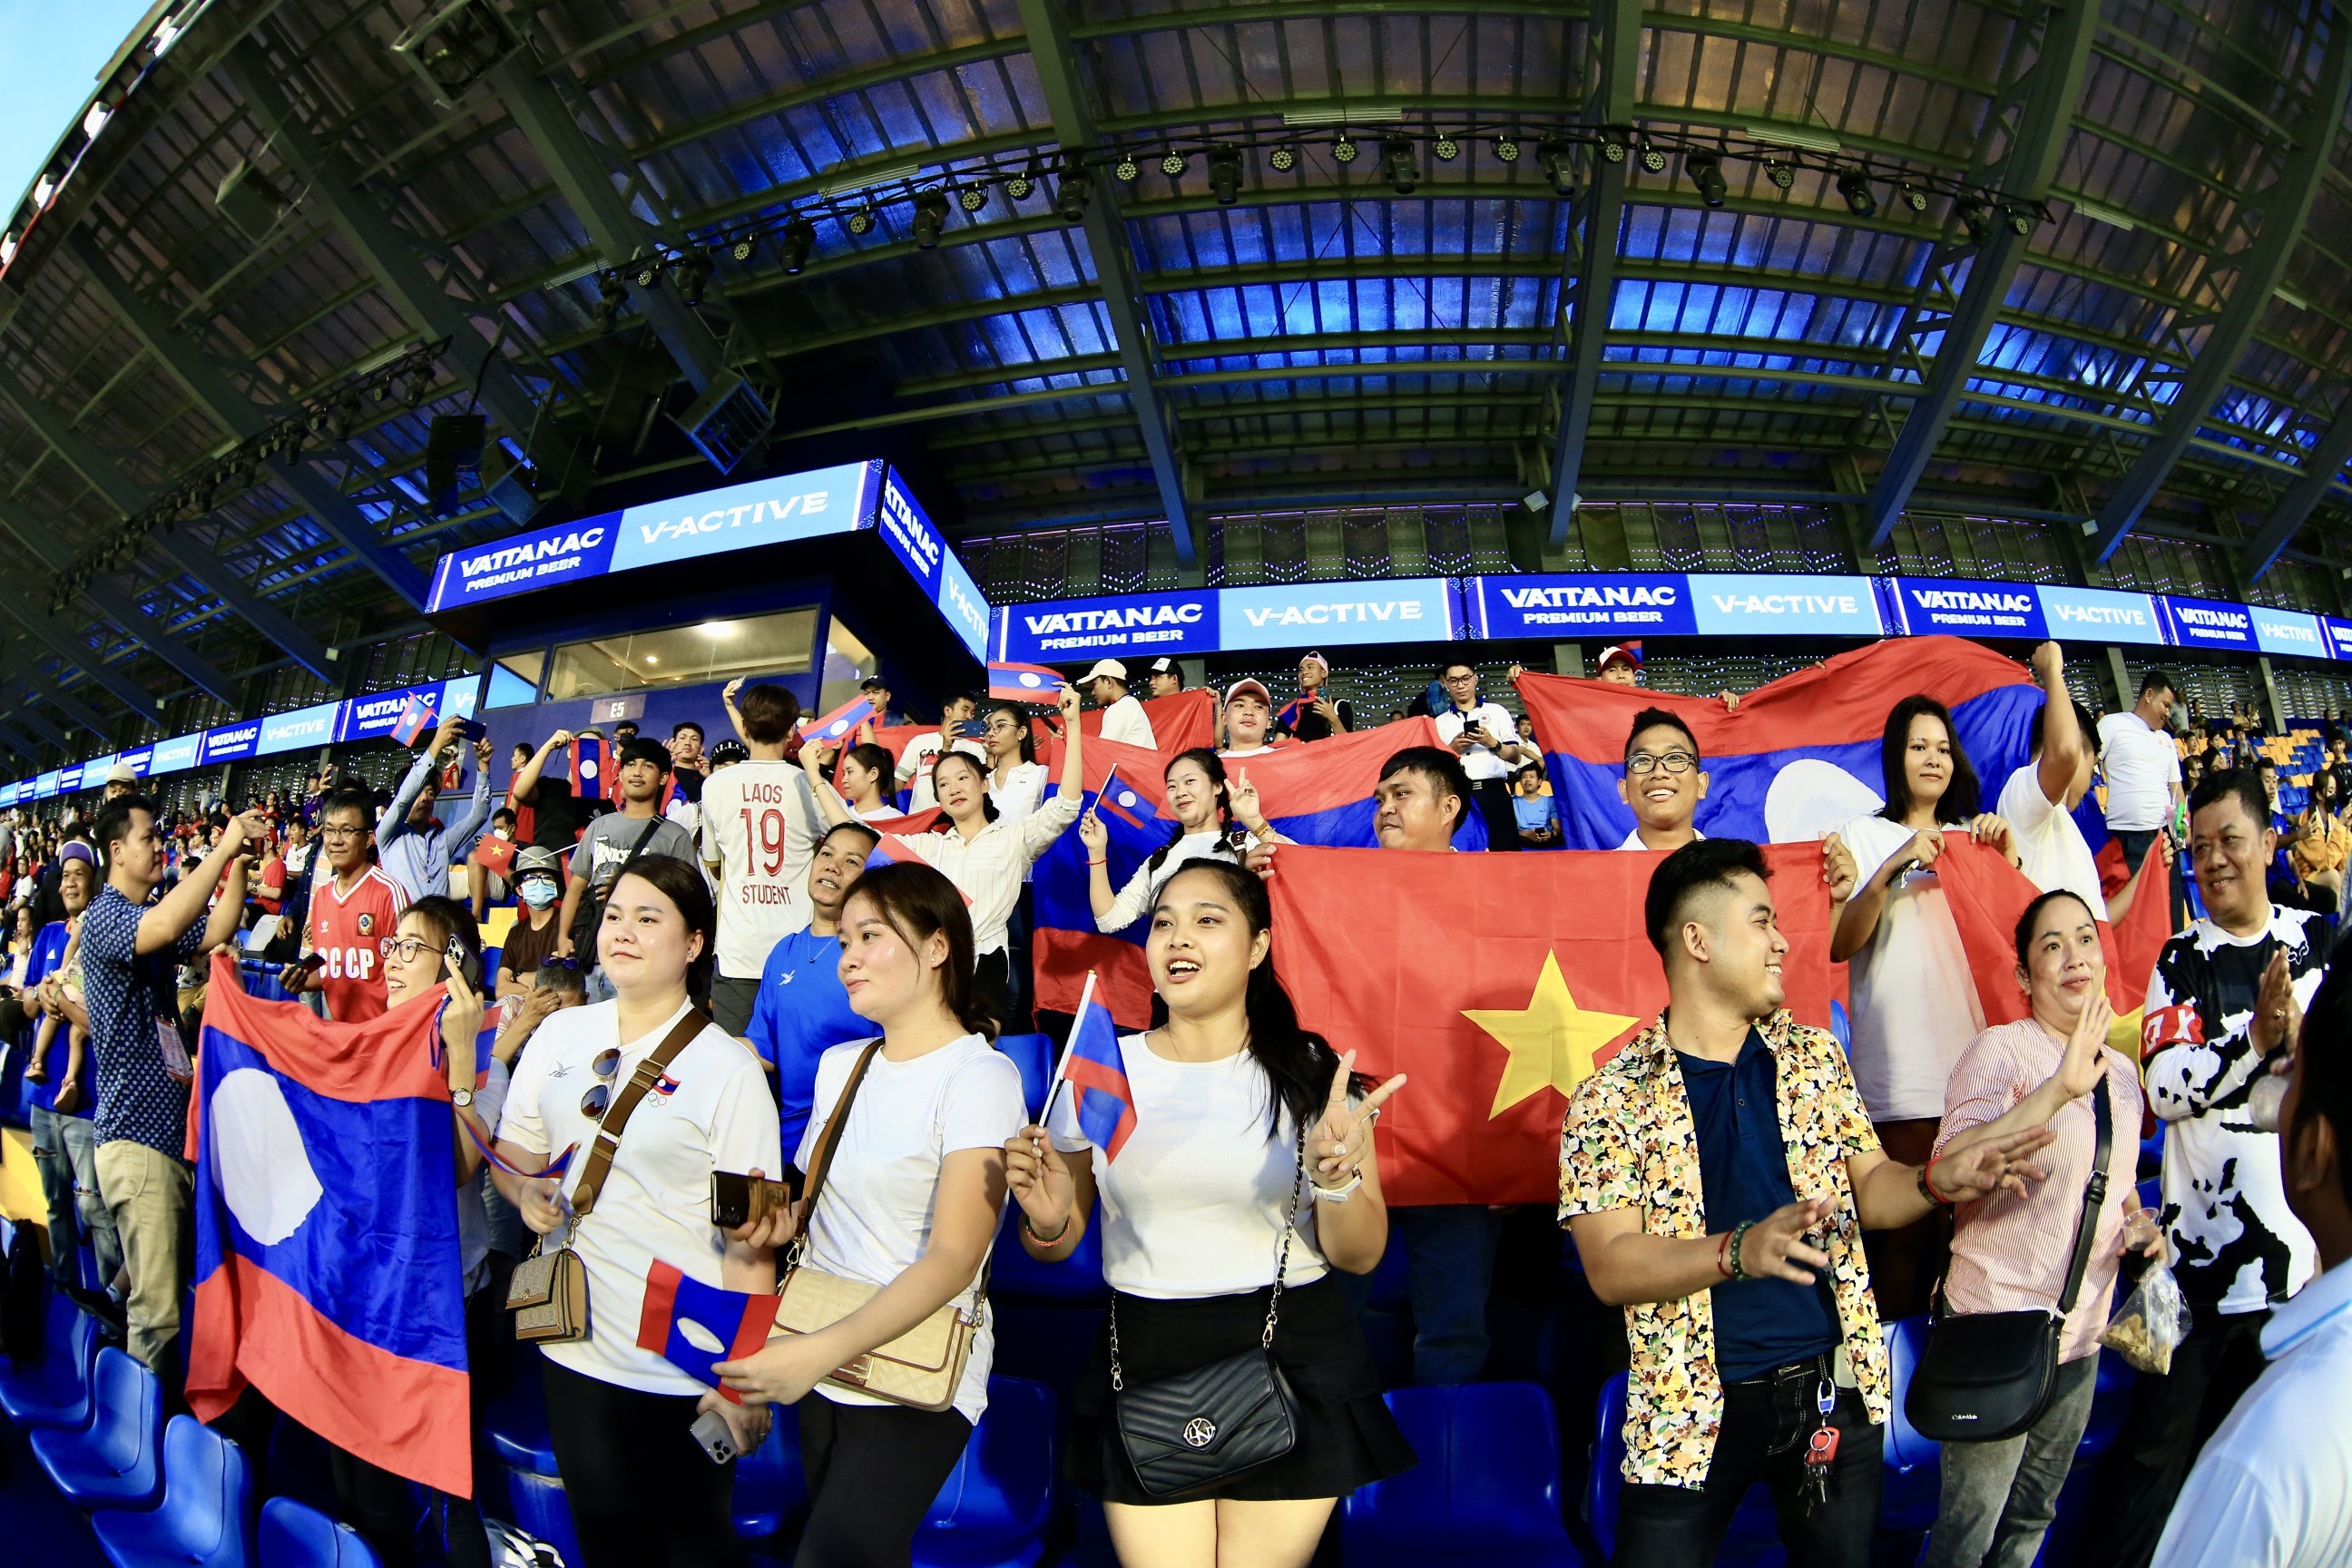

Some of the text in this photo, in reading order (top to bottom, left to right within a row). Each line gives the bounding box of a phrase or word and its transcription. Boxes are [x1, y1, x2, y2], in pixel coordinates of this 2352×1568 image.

[641, 491, 828, 544] V-ACTIVE
[460, 527, 604, 578] VATTANAC
[911, 545, 930, 577] BEER
[466, 555, 582, 593] PREMIUM BEER
[1501, 586, 1676, 608] VATTANAC
[1711, 594, 1858, 614] V-ACTIVE
[1911, 590, 2032, 612] VATTANAC
[1024, 603, 1202, 635] VATTANAC
[1244, 601, 1423, 627] V-ACTIVE
[1524, 611, 1664, 624] PREMIUM BEER
[1931, 613, 2027, 627] PREMIUM BEER
[2053, 603, 2146, 626] V-ACTIVE
[2175, 607, 2248, 629] VATTANAC
[1040, 629, 1183, 651] PREMIUM BEER
[2259, 622, 2316, 642] V-ACTIVE
[356, 692, 436, 720] VATTANC
[610, 702, 624, 719] E5
[267, 718, 326, 741] V-ACTIVE
[358, 716, 398, 730] PREMIUM
[208, 726, 258, 749] VATTANAC
[742, 783, 783, 804] LAOS
[740, 808, 786, 877] 19
[742, 884, 792, 906] STUDENT
